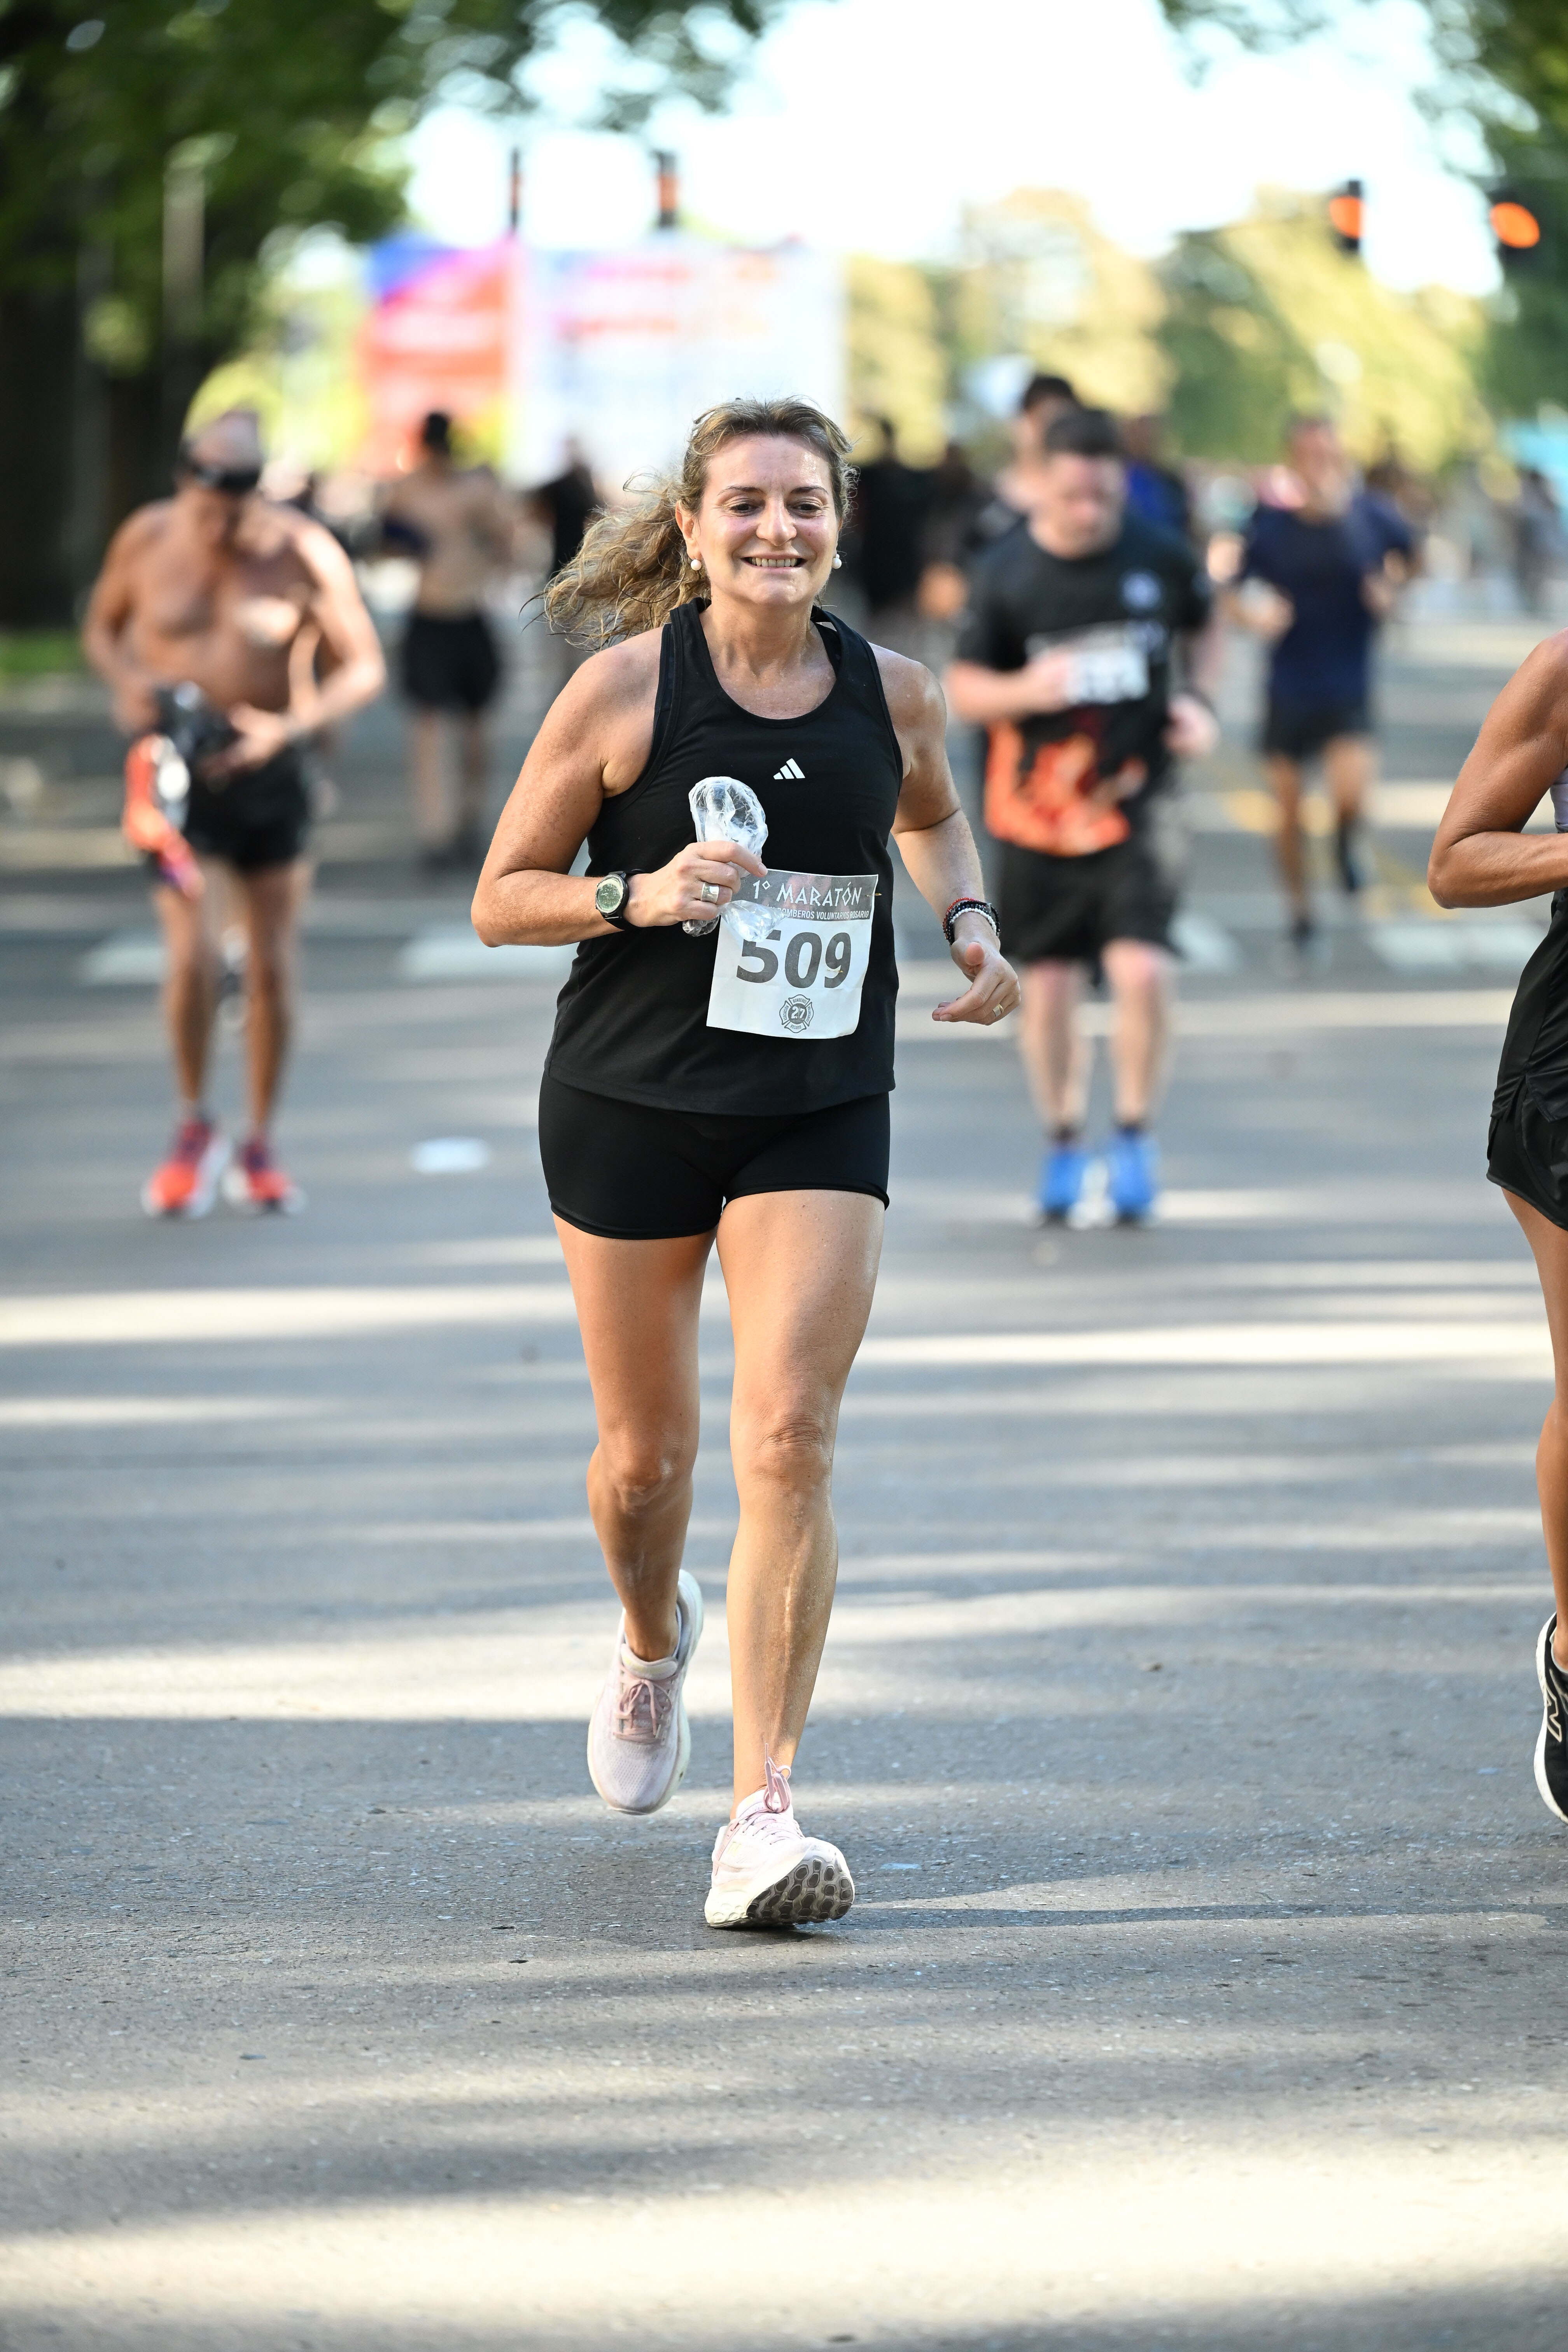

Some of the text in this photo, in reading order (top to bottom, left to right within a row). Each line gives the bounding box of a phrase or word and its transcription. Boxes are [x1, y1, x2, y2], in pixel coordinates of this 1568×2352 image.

[776, 881, 863, 907] MARATÓN
[777, 907, 870, 920] OMBEROS VOLUNTARIOS ROSARIO
[736, 929, 851, 989] 509
[791, 1006, 805, 1019] 27
